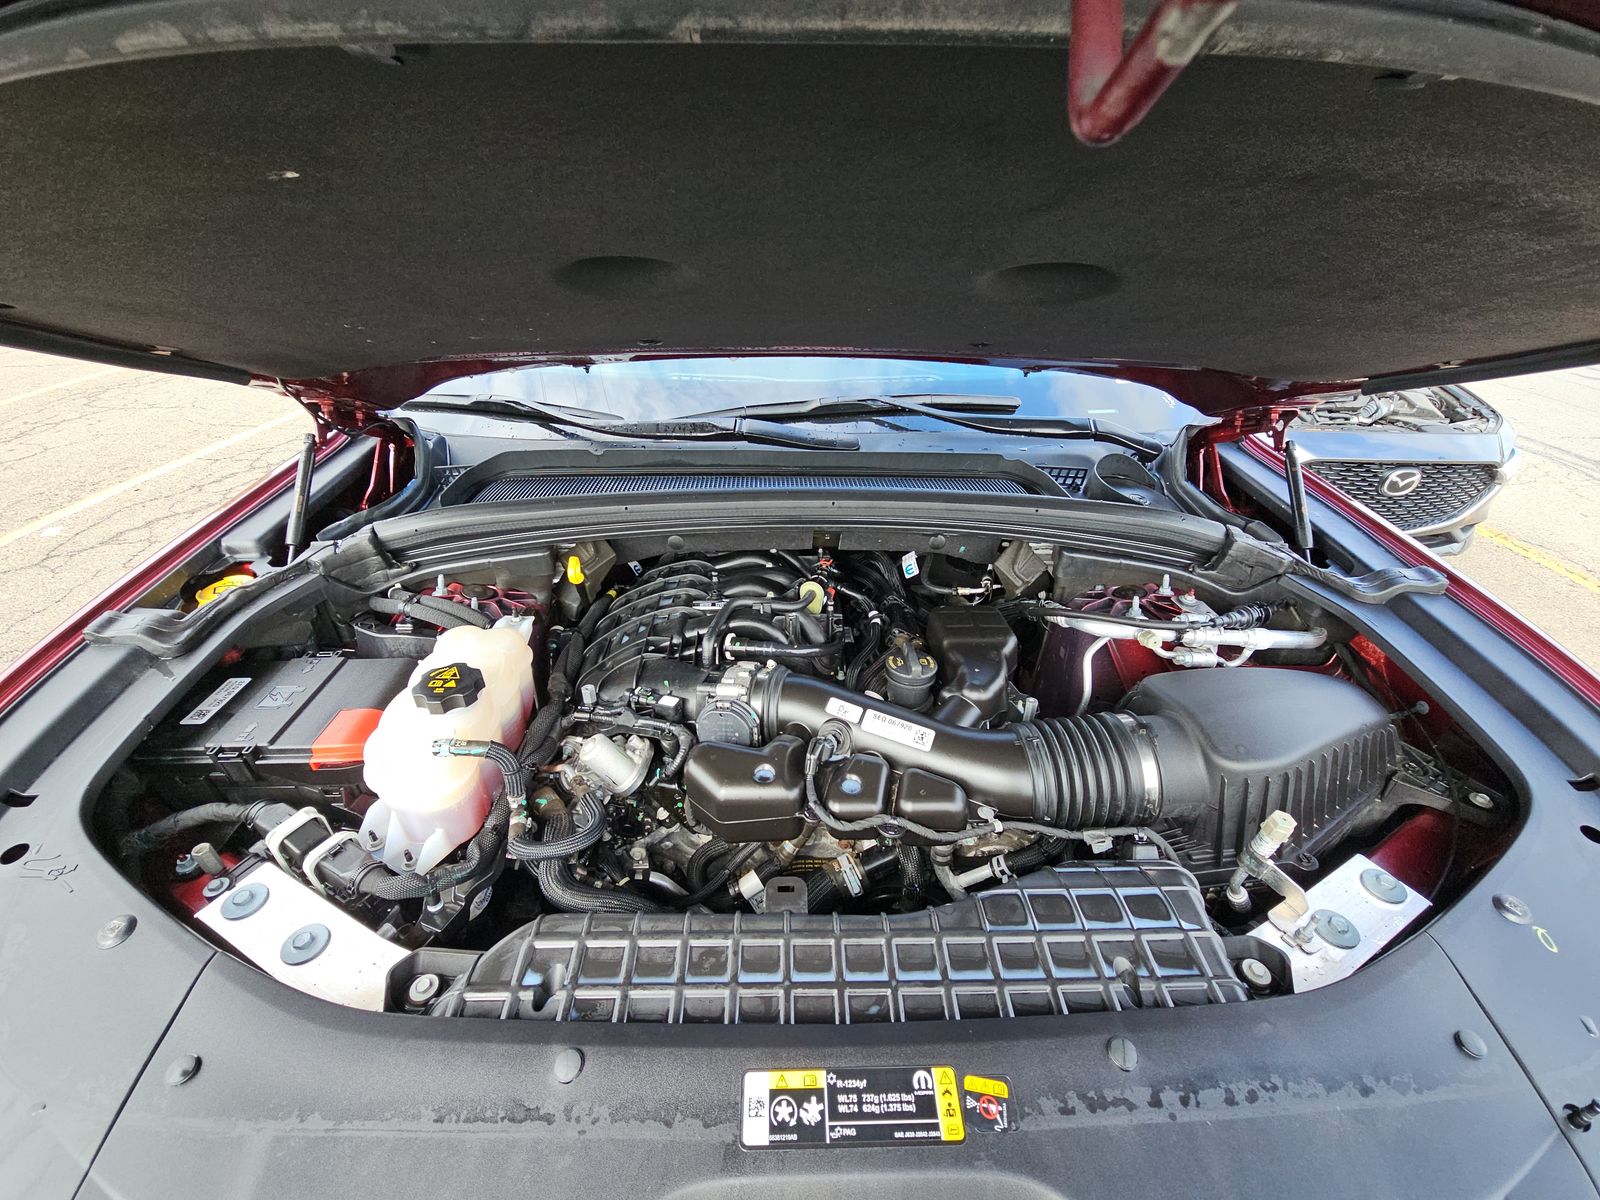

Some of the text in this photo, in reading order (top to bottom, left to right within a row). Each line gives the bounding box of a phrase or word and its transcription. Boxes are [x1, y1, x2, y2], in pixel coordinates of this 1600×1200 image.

[872, 713, 886, 723] SEQ
[836, 1079, 867, 1089] R-1234yf
[837, 1093, 915, 1104] WL75 737g (1.625 lbs)
[838, 1103, 916, 1114] WL74 624g (1.375 lbs)
[842, 1128, 857, 1136] PAG
